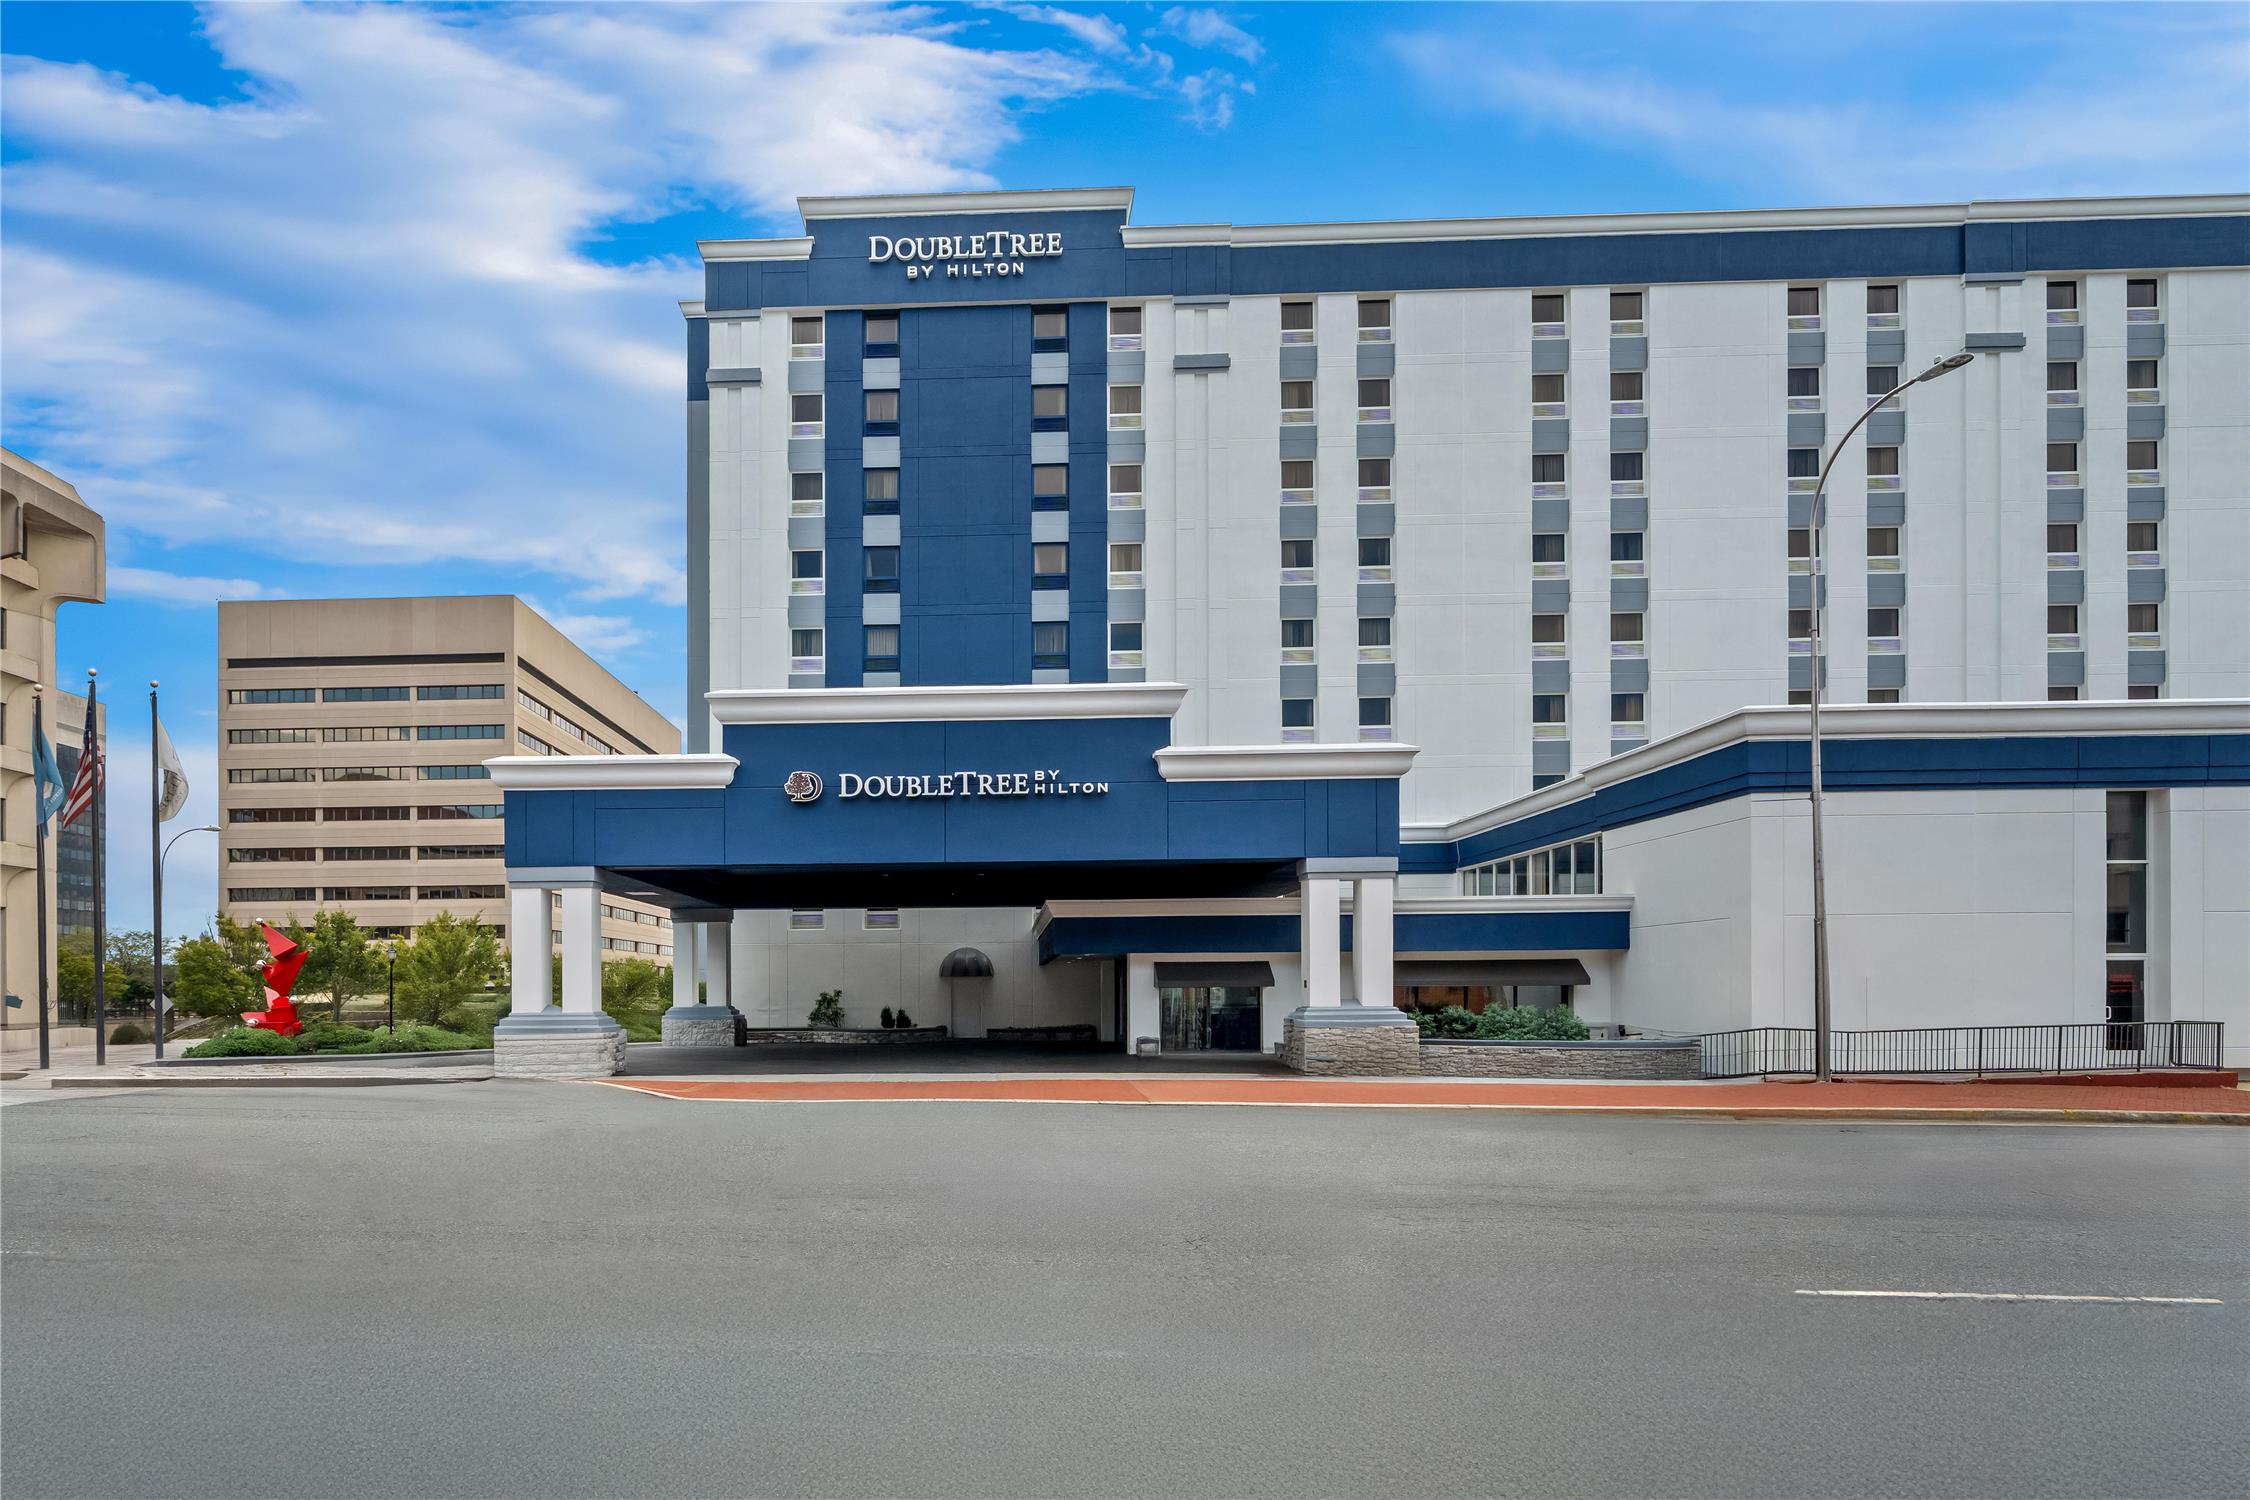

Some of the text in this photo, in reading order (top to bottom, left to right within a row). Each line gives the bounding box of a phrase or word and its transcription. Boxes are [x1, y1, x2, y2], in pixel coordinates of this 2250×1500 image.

[869, 231, 1063, 262] DOUBLETREE
[907, 262, 1025, 279] BY HILTON
[1034, 769, 1060, 781] BY
[838, 771, 1030, 798] DOUBLETREE
[1034, 782, 1109, 795] HILTON
